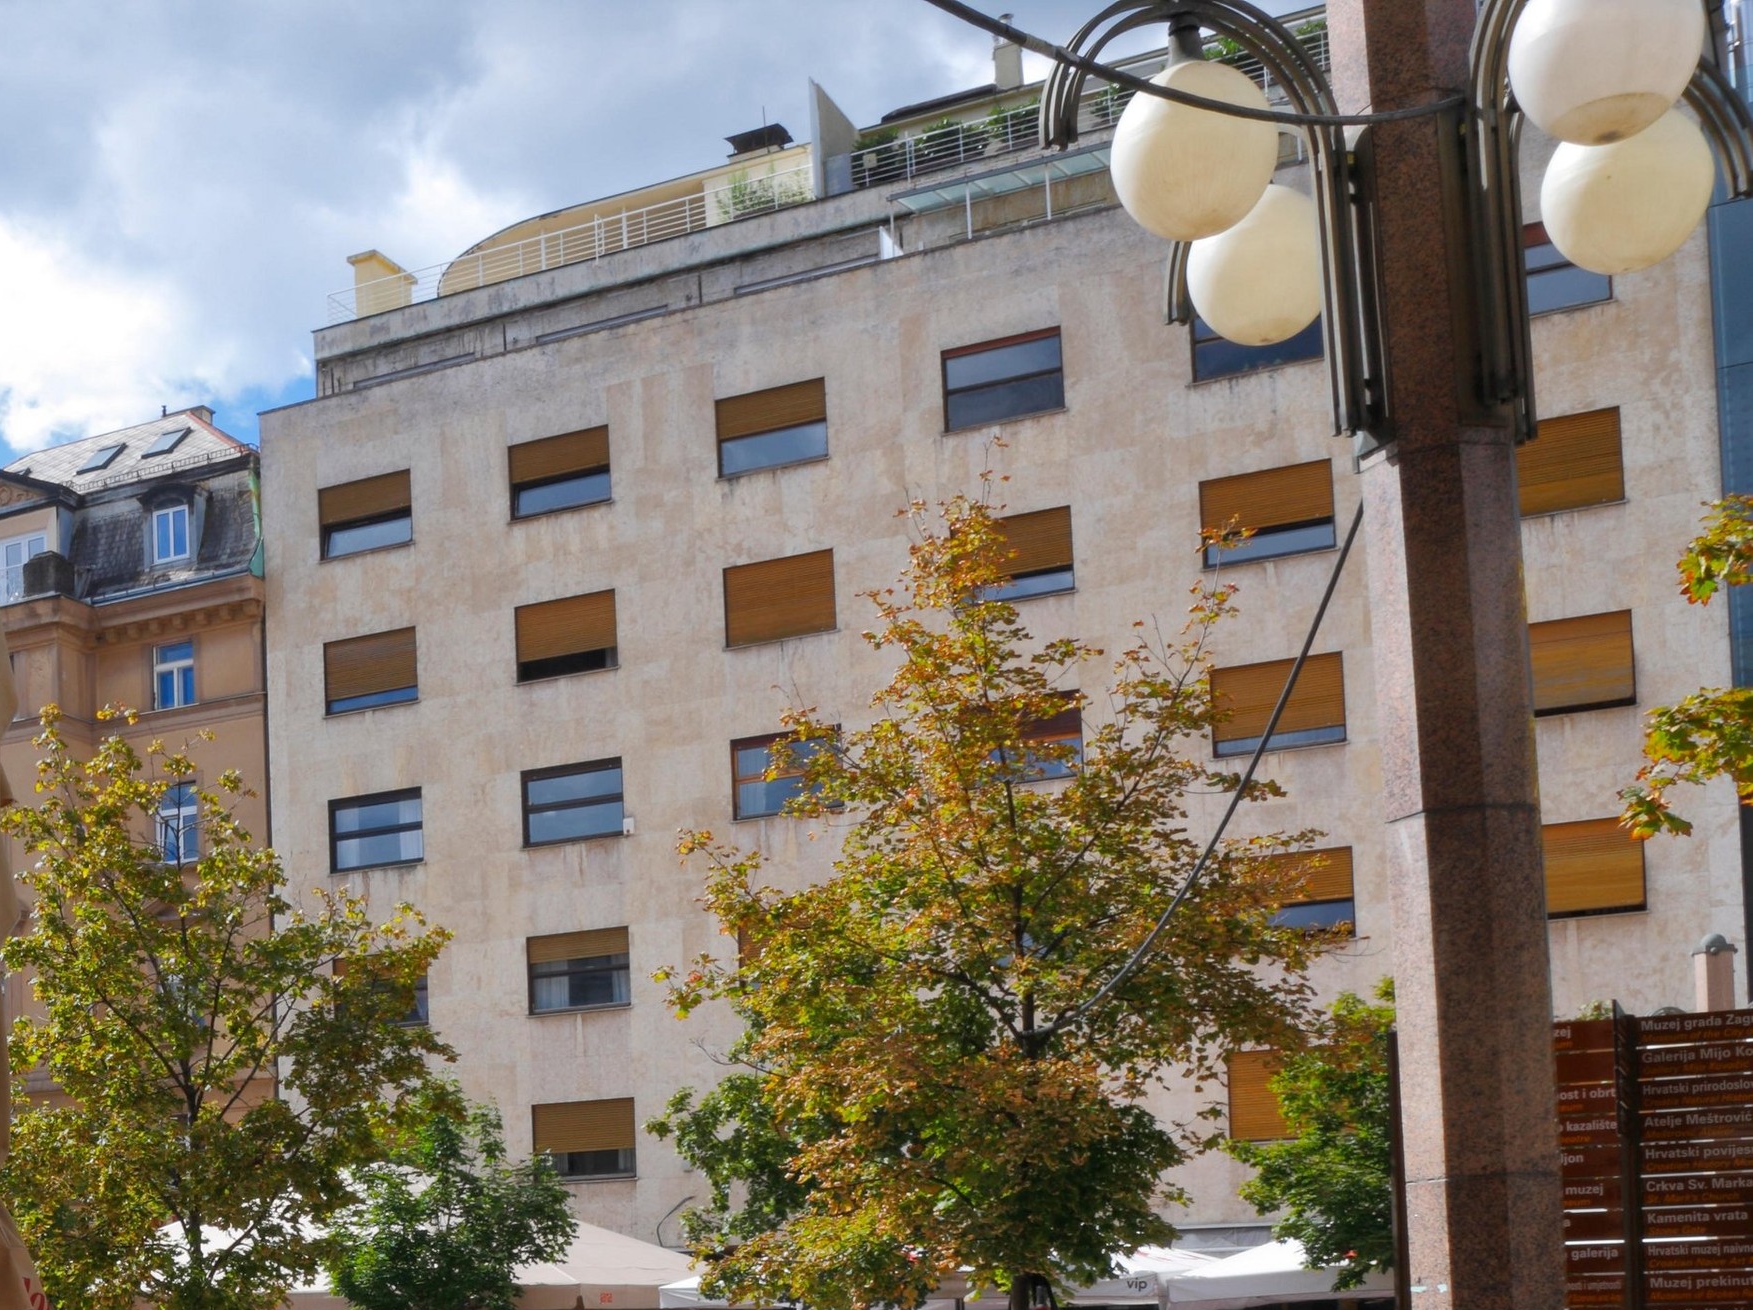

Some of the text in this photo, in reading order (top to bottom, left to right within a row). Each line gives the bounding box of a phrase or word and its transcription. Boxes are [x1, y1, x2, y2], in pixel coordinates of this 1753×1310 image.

[1641, 1018, 1680, 1031] Muzej
[1684, 1016, 1722, 1030] grada
[1553, 1026, 1571, 1039] zej
[1642, 1050, 1695, 1063] Galerija
[1700, 1048, 1731, 1060] Mijo
[1557, 1090, 1579, 1100] ost
[1589, 1088, 1616, 1099] obrt
[1642, 1083, 1689, 1095] Hrvatski
[1566, 1120, 1618, 1131] kazalište
[1644, 1111, 1752, 1128] Atelje Meštrović
[1560, 1153, 1584, 1166] ljon
[1646, 1147, 1700, 1160] Hrvatski
[1565, 1183, 1604, 1196] muzej
[1646, 1177, 1753, 1192] Crkva Sv. Marka
[1647, 1210, 1748, 1224] Kamenita vrata
[1571, 1247, 1619, 1261] galerija
[1648, 1244, 1689, 1256] Hrvatski
[1691, 1243, 1721, 1256] muzej
[1126, 1277, 1148, 1292] vip
[1650, 1275, 1753, 1290] Muzej prekinut
